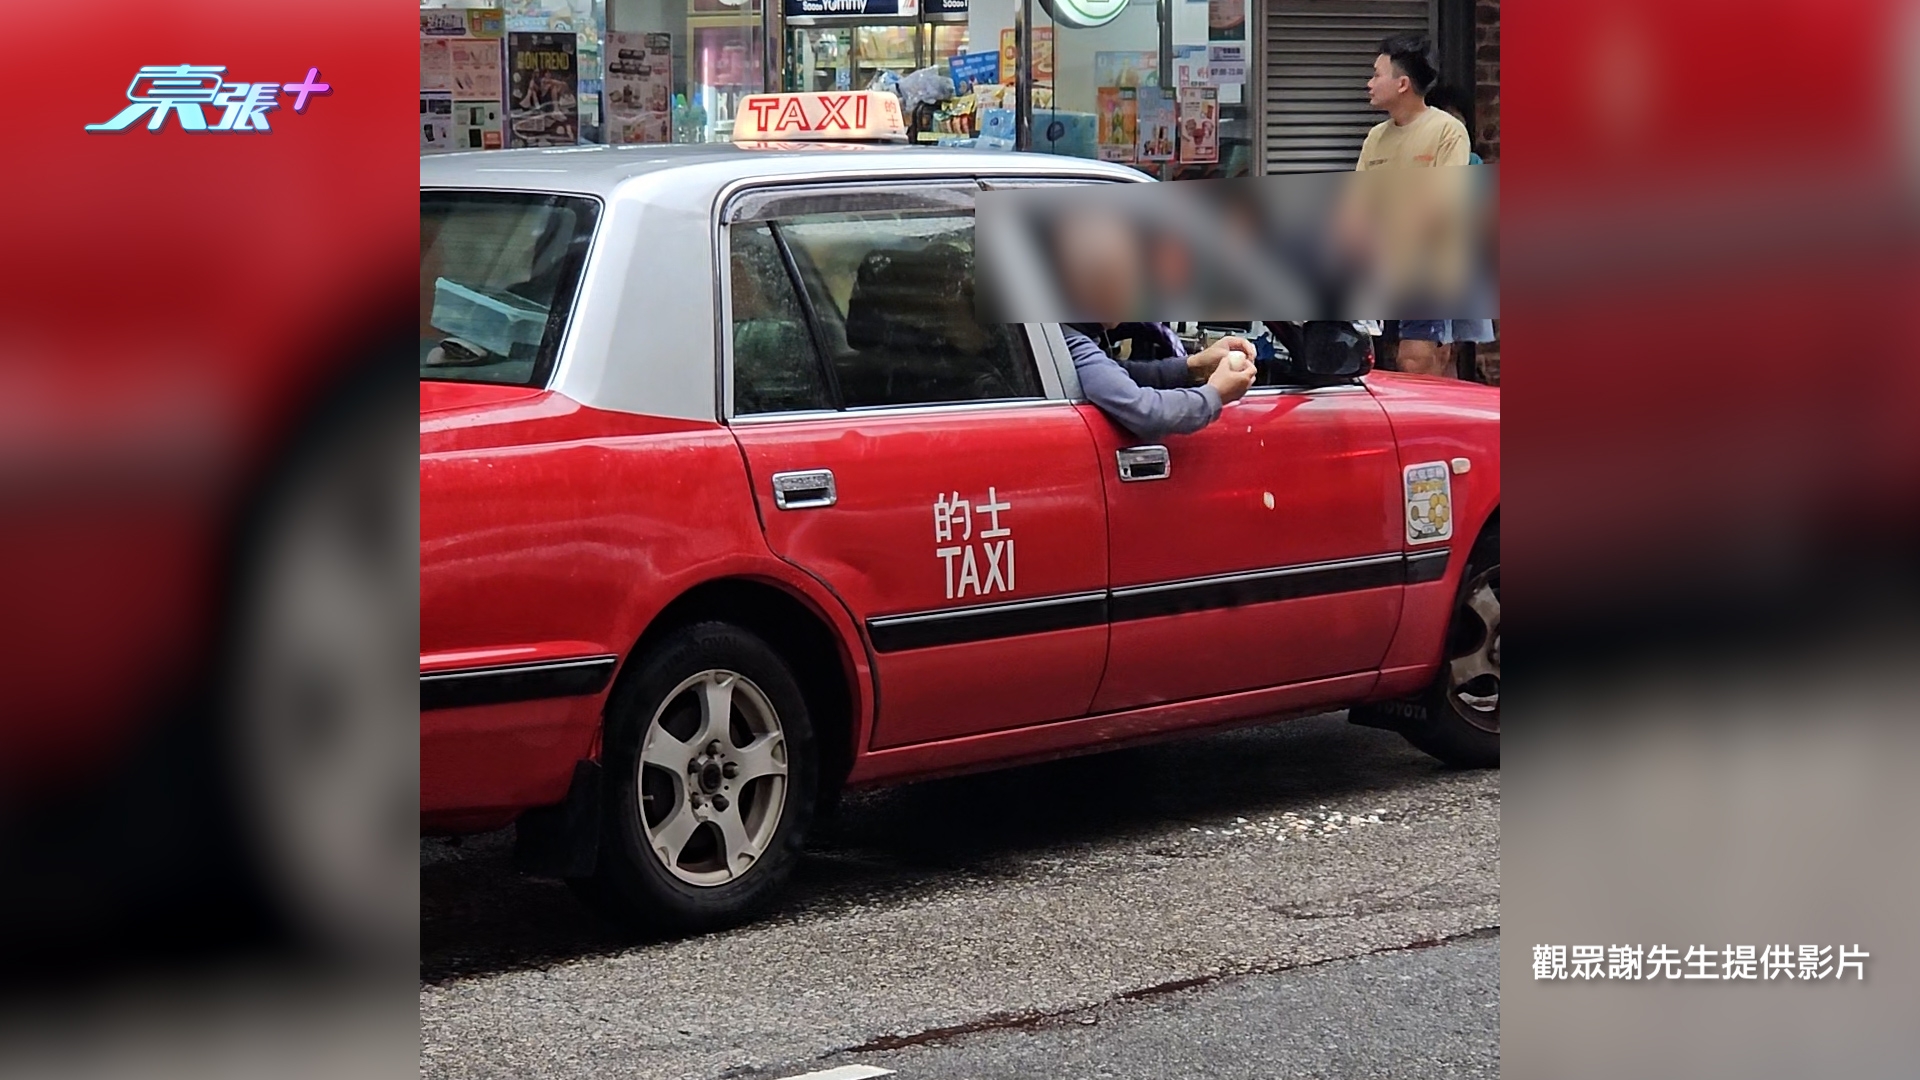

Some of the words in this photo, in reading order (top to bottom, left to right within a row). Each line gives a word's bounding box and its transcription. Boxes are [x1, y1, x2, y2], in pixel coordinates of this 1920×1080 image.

[748, 94, 868, 132] TAXI
[884, 100, 899, 129] 的士
[933, 486, 1011, 543] 的士
[936, 539, 1015, 599] TAXI
